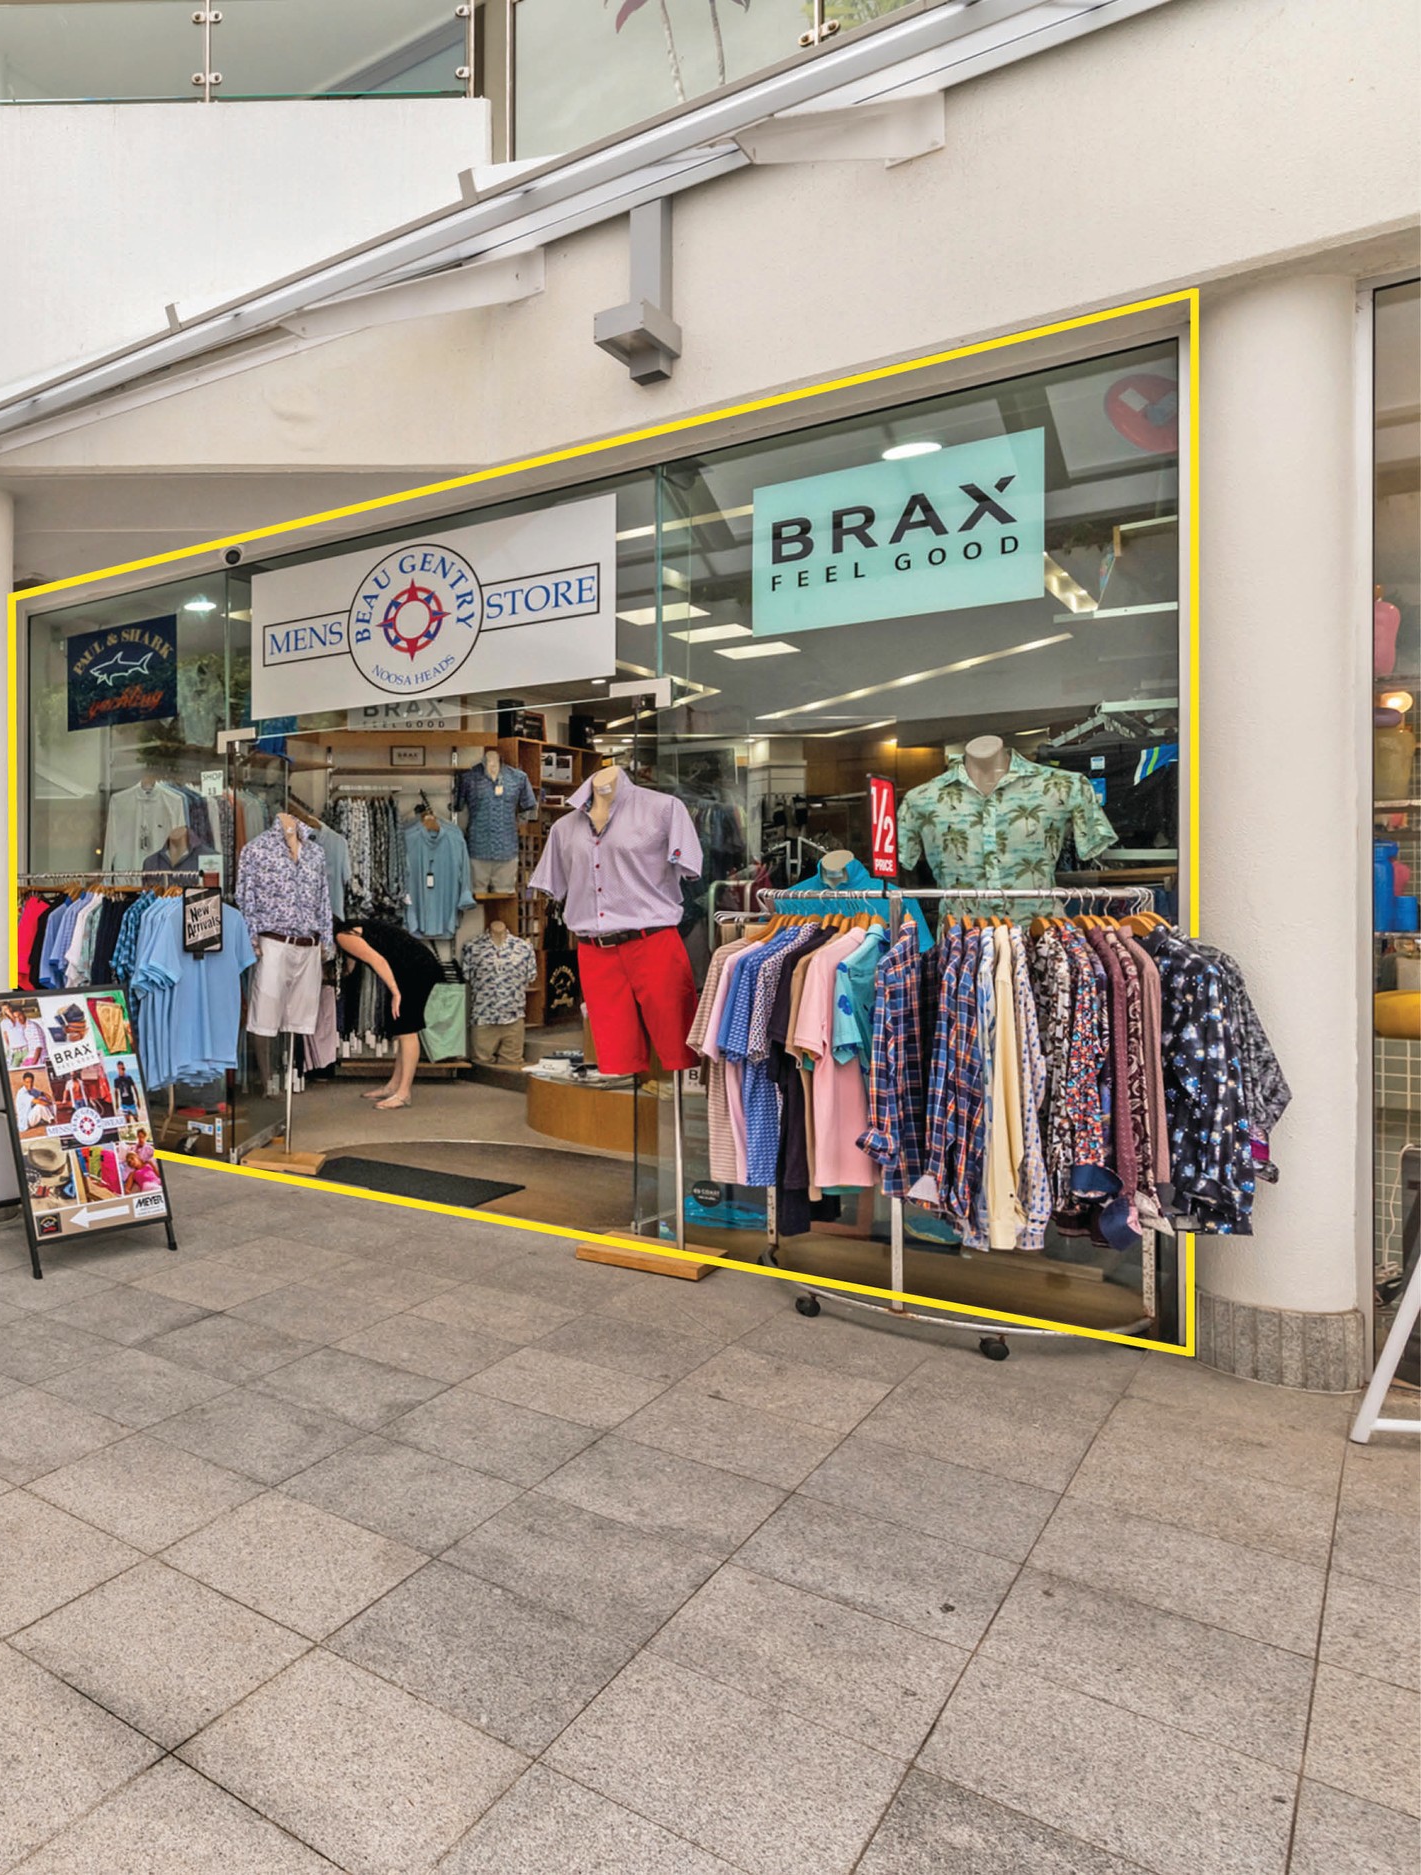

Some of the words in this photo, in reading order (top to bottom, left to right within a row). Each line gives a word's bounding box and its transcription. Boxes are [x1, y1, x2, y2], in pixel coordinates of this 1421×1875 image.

[771, 475, 1018, 565] BRAX
[771, 562, 866, 592] FEEL
[894, 535, 1020, 571] GOOD
[355, 568, 392, 644] BEAU
[398, 552, 476, 630] GENTRY
[269, 621, 344, 656] MENS
[486, 575, 596, 619] STORE
[73, 641, 105, 675] PAUL
[106, 632, 118, 647] &
[120, 629, 174, 659] SHARK
[371, 664, 412, 686] NOOSA
[414, 654, 456, 685] HEADS
[405, 720, 445, 729] GOOD
[203, 772, 222, 781] SHOP
[871, 786, 894, 853] 1/2
[874, 858, 894, 872] PRICE
[187, 916, 221, 939] Arrivals
[190, 906, 210, 923] New
[54, 1043, 92, 1064] BRAX
[136, 1194, 164, 1208] MEYER
